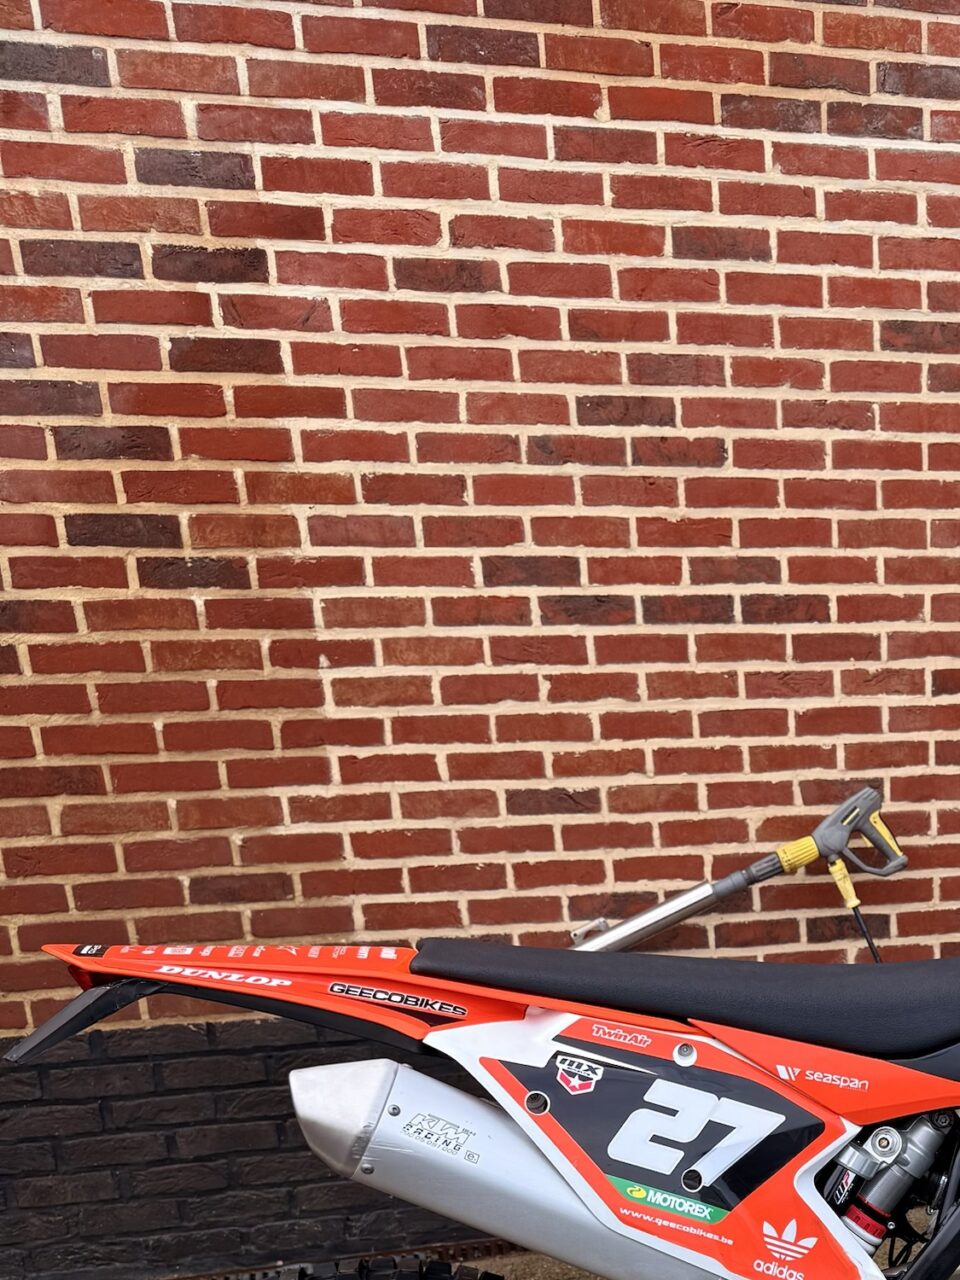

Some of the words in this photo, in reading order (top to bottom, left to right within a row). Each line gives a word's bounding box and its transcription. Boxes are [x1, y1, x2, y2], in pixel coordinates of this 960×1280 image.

[154, 964, 293, 987] DUNLOP
[329, 982, 467, 1017] GEECOBIKES
[804, 1069, 870, 1091] seaspan
[403, 1123, 463, 1152] RACING
[409, 1113, 470, 1145] KTM
[607, 1078, 786, 1187] 27
[646, 1189, 713, 1220] MOTOREX
[619, 1207, 734, 1246] www.geecobikes.be
